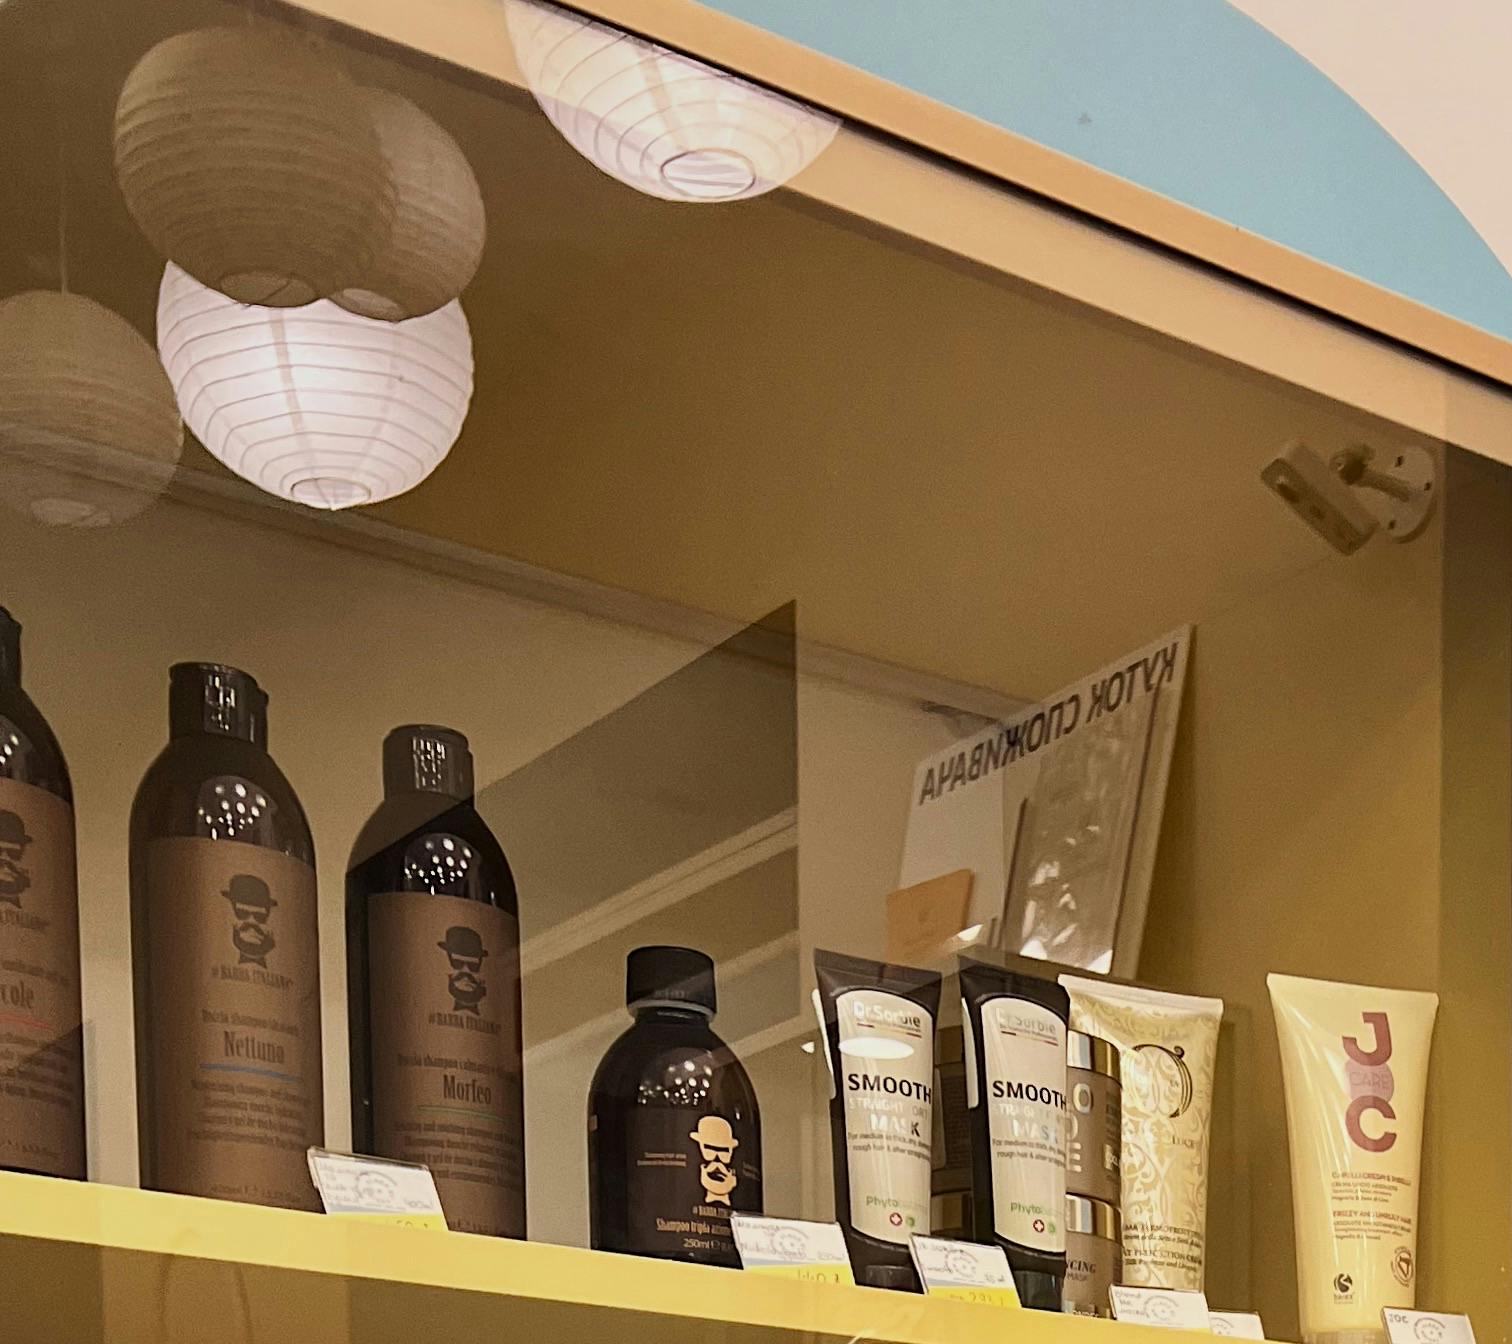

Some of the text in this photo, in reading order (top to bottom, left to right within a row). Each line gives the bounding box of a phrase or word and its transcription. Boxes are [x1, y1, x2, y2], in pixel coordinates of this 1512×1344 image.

[223, 1030, 285, 1064] Nettuno
[443, 1073, 493, 1105] Morfeo
[848, 1073, 932, 1105] SMOOTH
[992, 1079, 1067, 1112] SMOOTH
